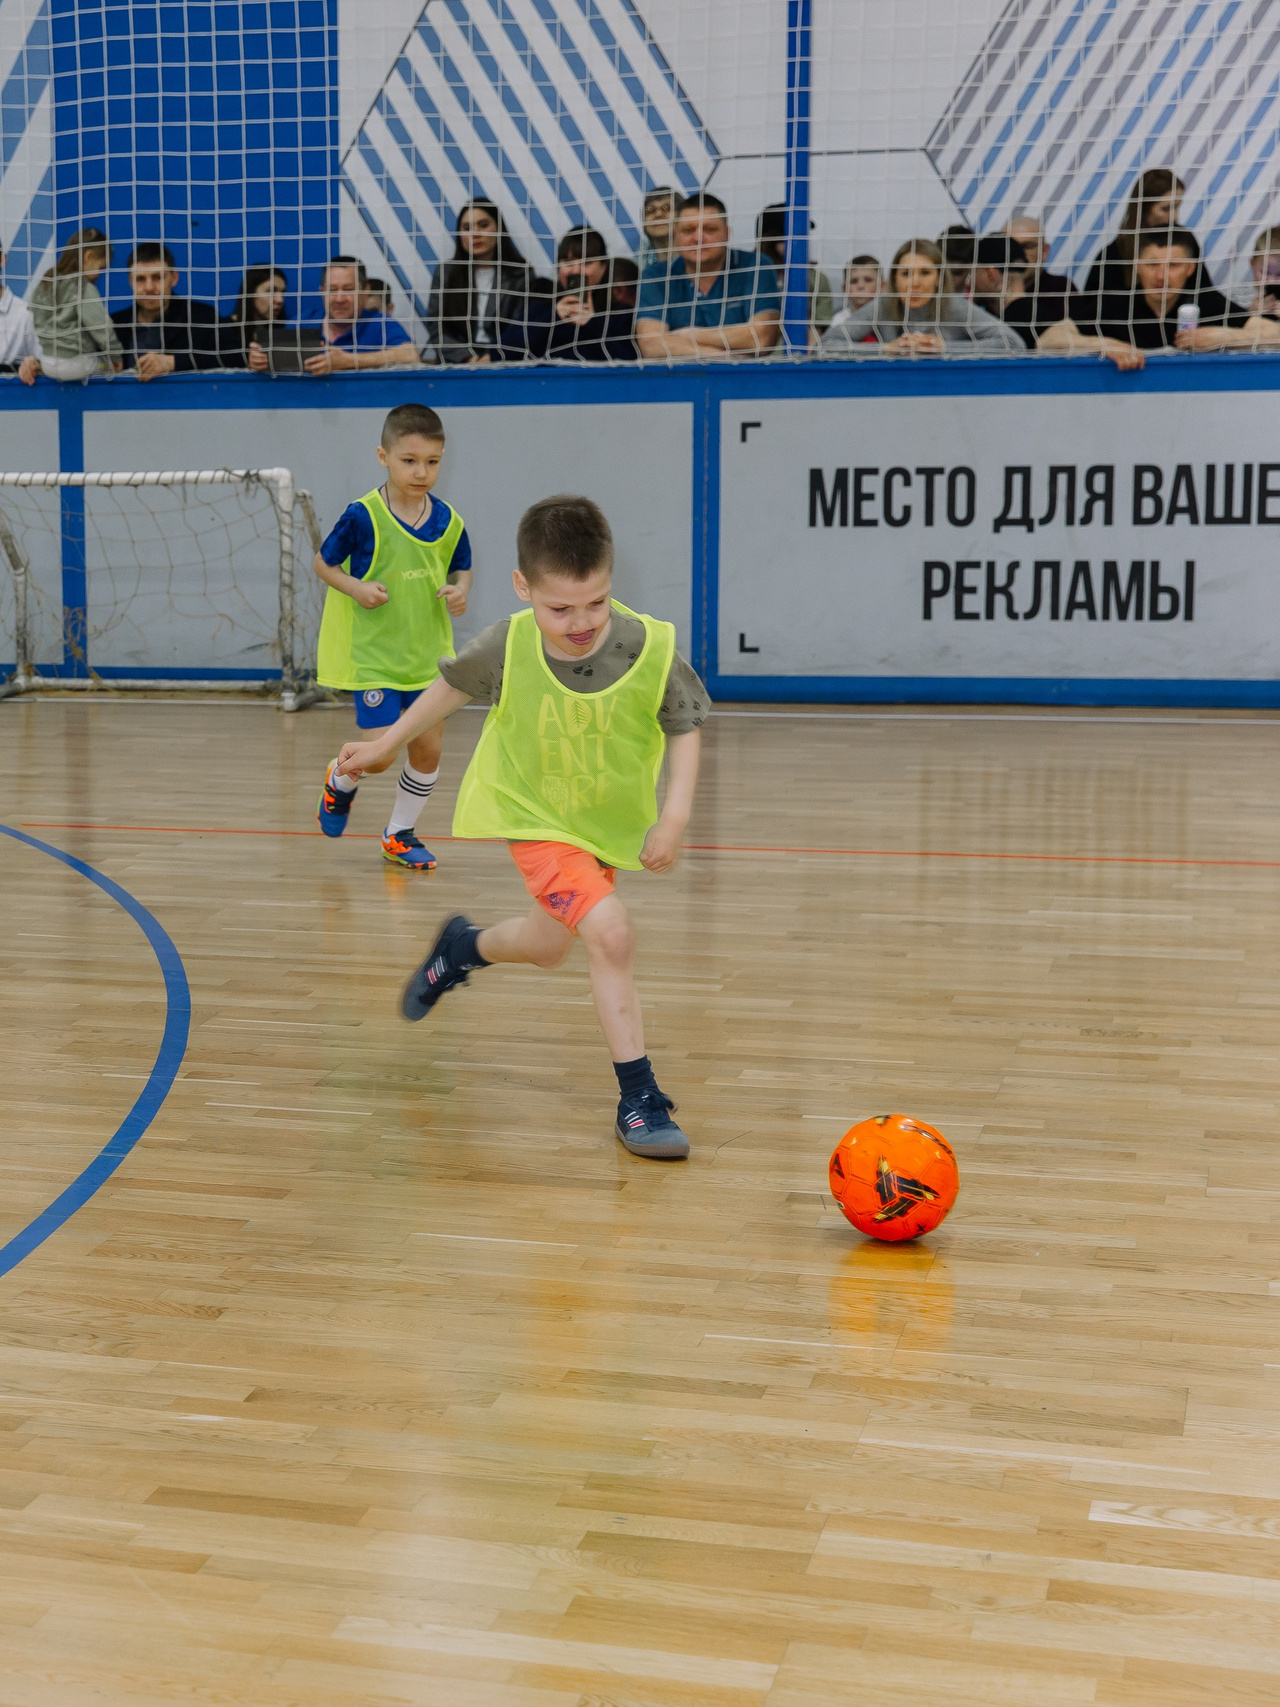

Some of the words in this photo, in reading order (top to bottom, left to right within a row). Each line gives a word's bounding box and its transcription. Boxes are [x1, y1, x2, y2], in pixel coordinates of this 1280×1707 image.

[808, 466, 977, 528] МЕСТО
[993, 464, 1115, 534] ДЛЯ
[1132, 462, 1280, 526] ВАШЕ
[923, 560, 1196, 621] РЕКЛАМЫ
